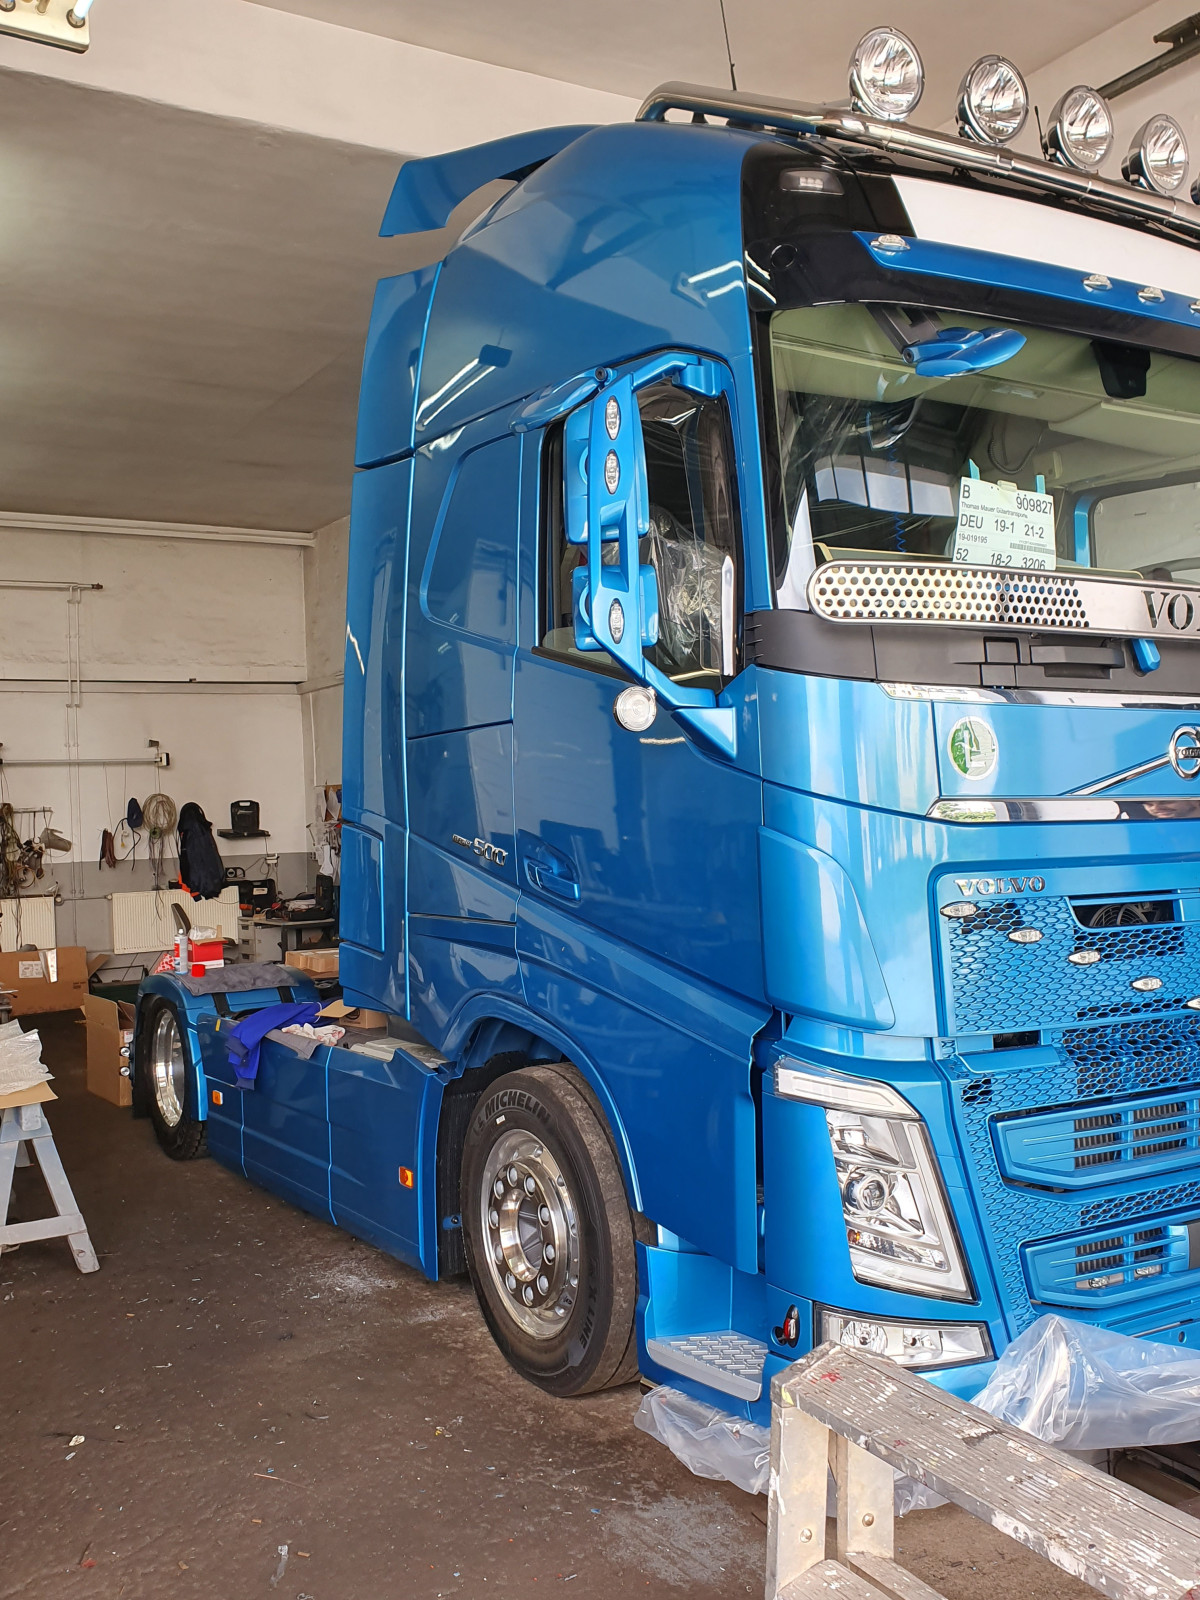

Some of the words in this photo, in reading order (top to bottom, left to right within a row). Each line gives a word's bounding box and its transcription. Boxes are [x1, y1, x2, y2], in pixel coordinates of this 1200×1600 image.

[961, 501, 980, 510] Thomas
[980, 504, 996, 513] Mauer
[962, 484, 971, 499] B
[1016, 496, 1053, 515] 909827
[958, 532, 988, 544] 19-019195
[960, 513, 984, 529] DEU
[994, 518, 1014, 533] 19-1
[1024, 523, 1045, 539] 21-2
[955, 548, 969, 561] 52
[990, 552, 1013, 566] 18-2
[1021, 556, 1046, 570] 3206
[473, 837, 507, 866] 500
[954, 875, 1046, 897] VOLVO
[485, 1090, 551, 1124] MICHELIN
